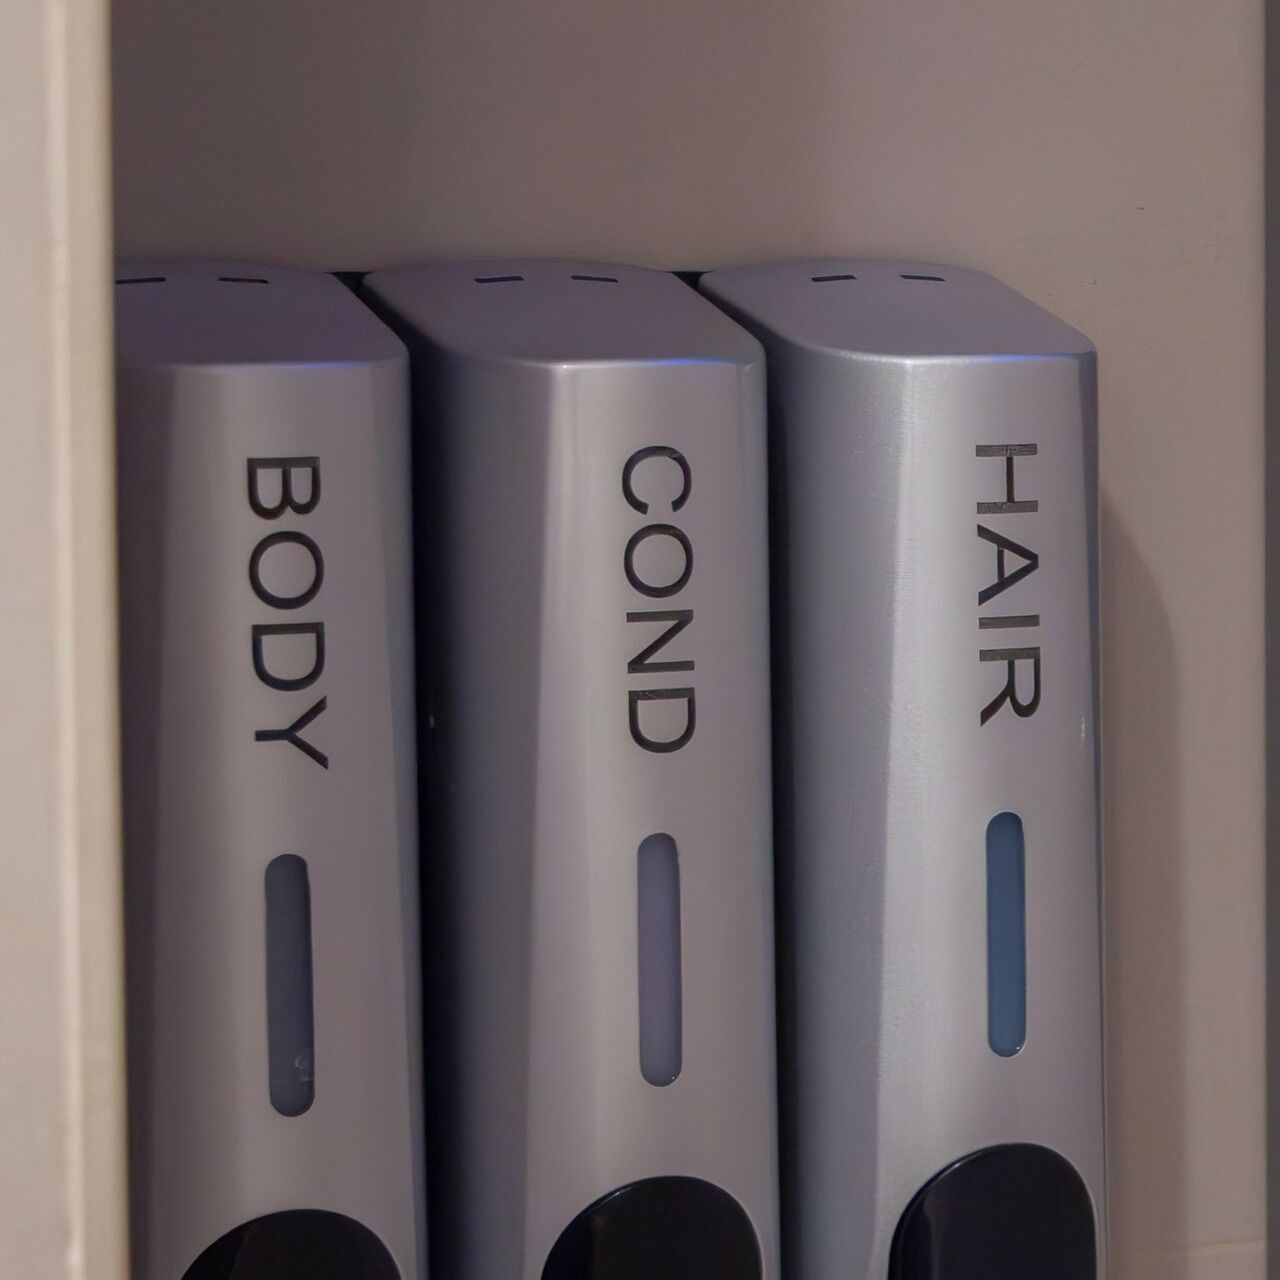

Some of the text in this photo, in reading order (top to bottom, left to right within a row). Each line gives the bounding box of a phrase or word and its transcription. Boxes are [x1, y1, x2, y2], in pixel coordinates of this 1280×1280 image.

[245, 456, 330, 771] BODY
[620, 445, 696, 754] COND
[975, 442, 1041, 727] HAIR
